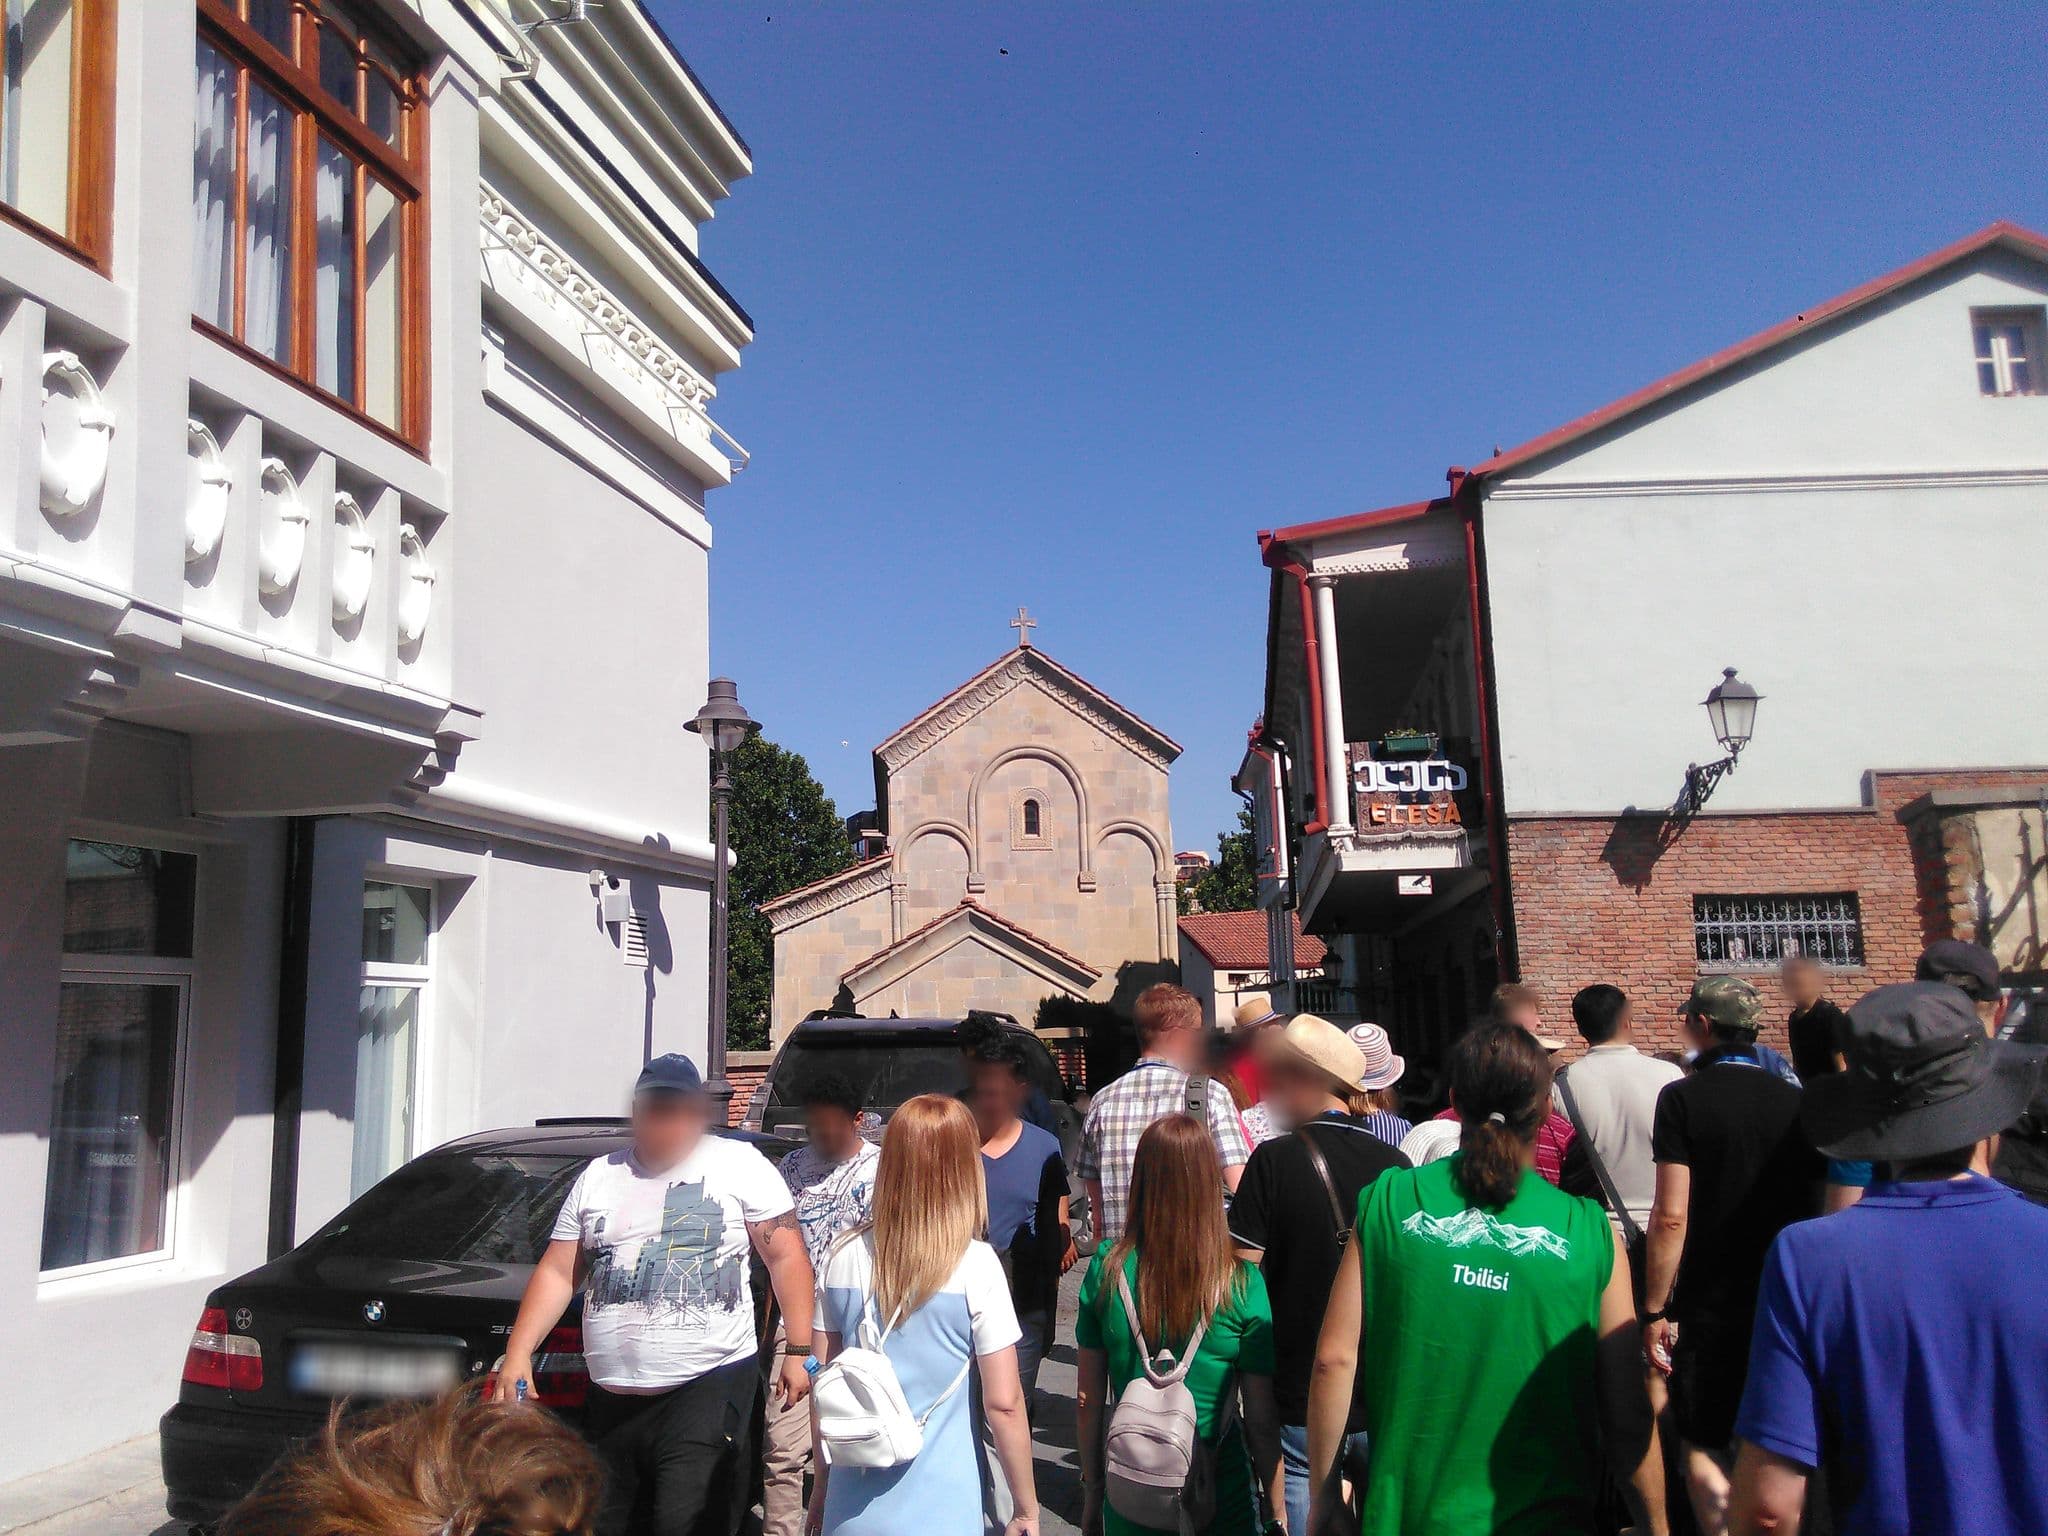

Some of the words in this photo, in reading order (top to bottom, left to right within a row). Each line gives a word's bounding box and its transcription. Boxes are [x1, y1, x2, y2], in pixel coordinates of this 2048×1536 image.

[1354, 760, 1468, 792] ელესა
[1371, 802, 1461, 824] ELESA
[1453, 1264, 1509, 1291] Tbilisi
